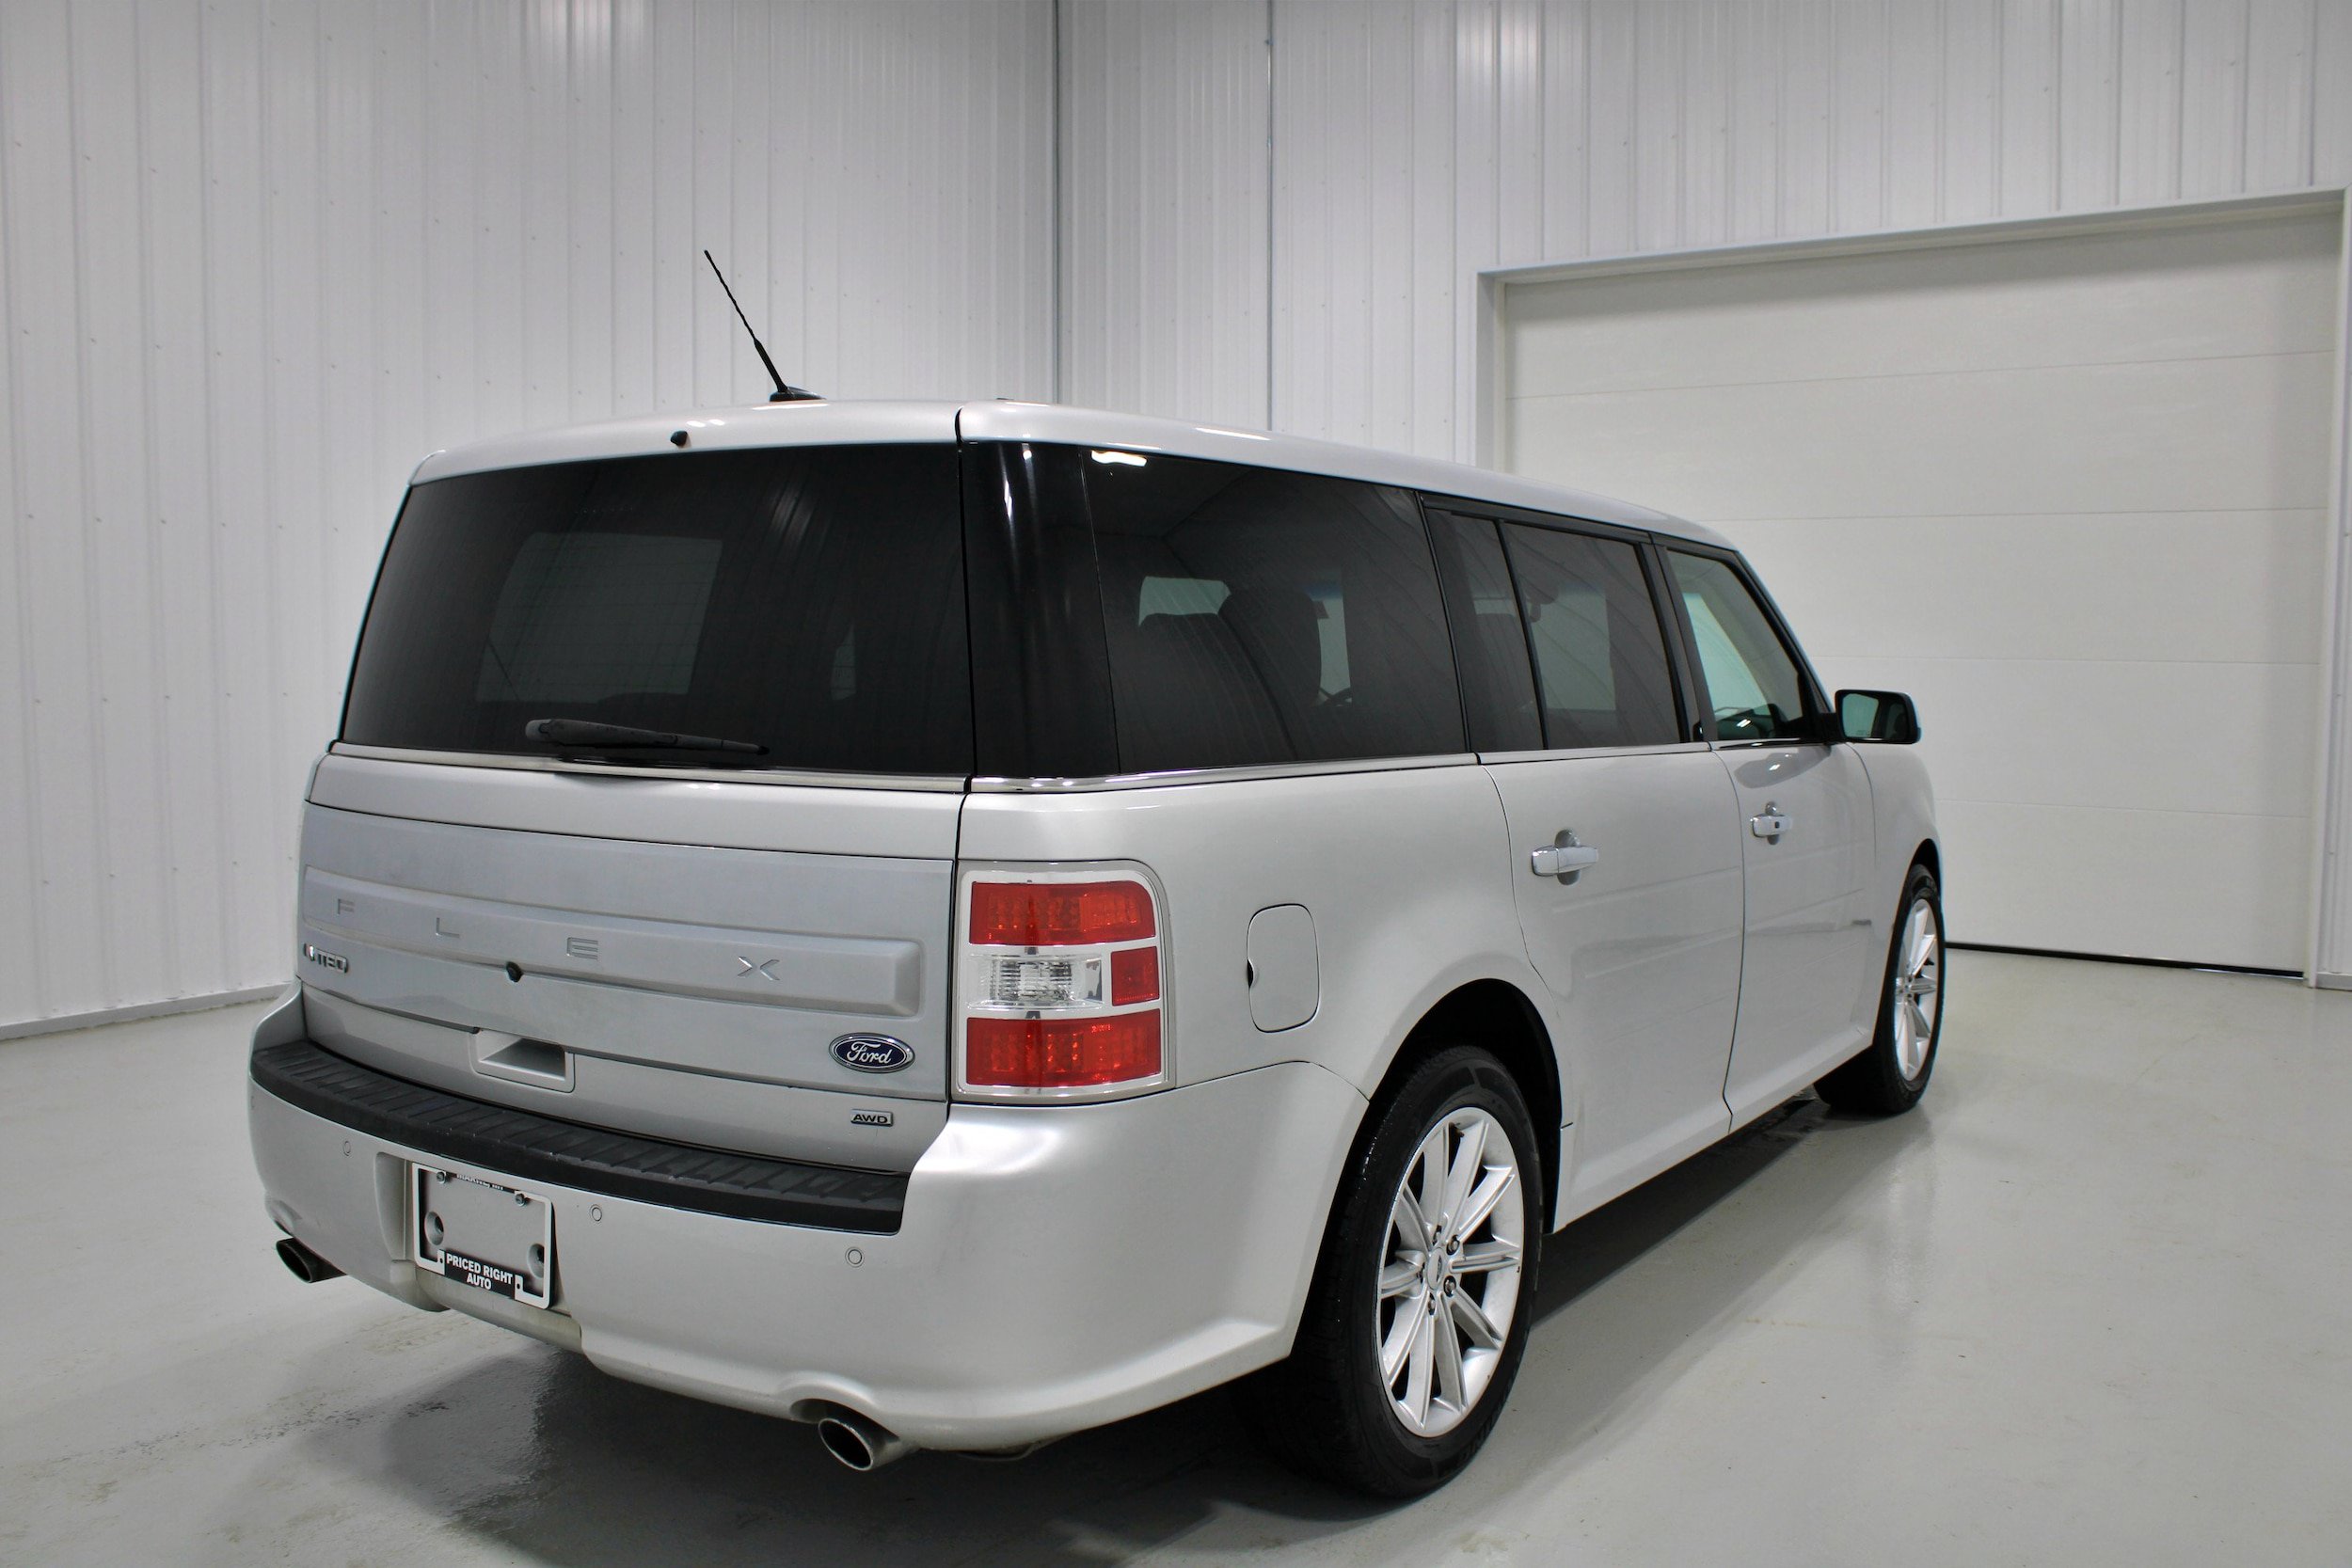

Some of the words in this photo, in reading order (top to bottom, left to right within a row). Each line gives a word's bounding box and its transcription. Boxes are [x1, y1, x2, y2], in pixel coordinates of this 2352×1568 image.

[337, 898, 780, 981] FLEX
[847, 1041, 892, 1063] Ford
[853, 1114, 888, 1123] AWD
[446, 1253, 482, 1274] PRICED
[483, 1265, 513, 1285] RIGHT
[467, 1273, 492, 1291] AUTO
